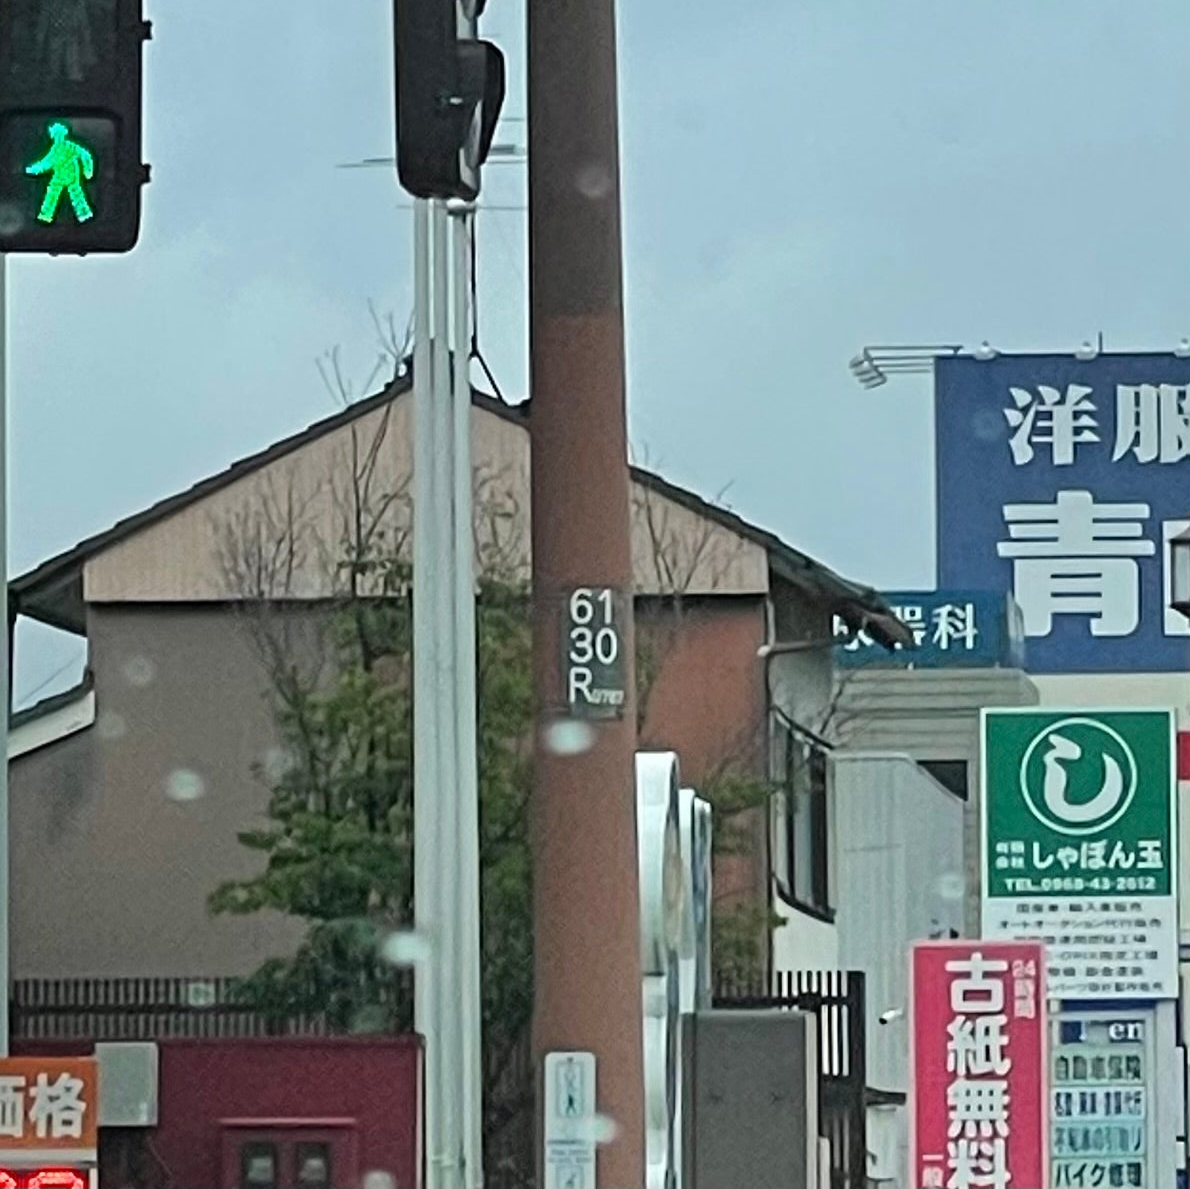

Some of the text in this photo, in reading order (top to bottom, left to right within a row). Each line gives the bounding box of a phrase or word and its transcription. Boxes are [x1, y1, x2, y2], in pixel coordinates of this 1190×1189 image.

[569, 587, 613, 625] 61
[569, 626, 618, 665] 30
[568, 666, 594, 704] R
[1033, 839, 1164, 871] しゃぼん玉
[945, 952, 1012, 1189] 古紙無料
